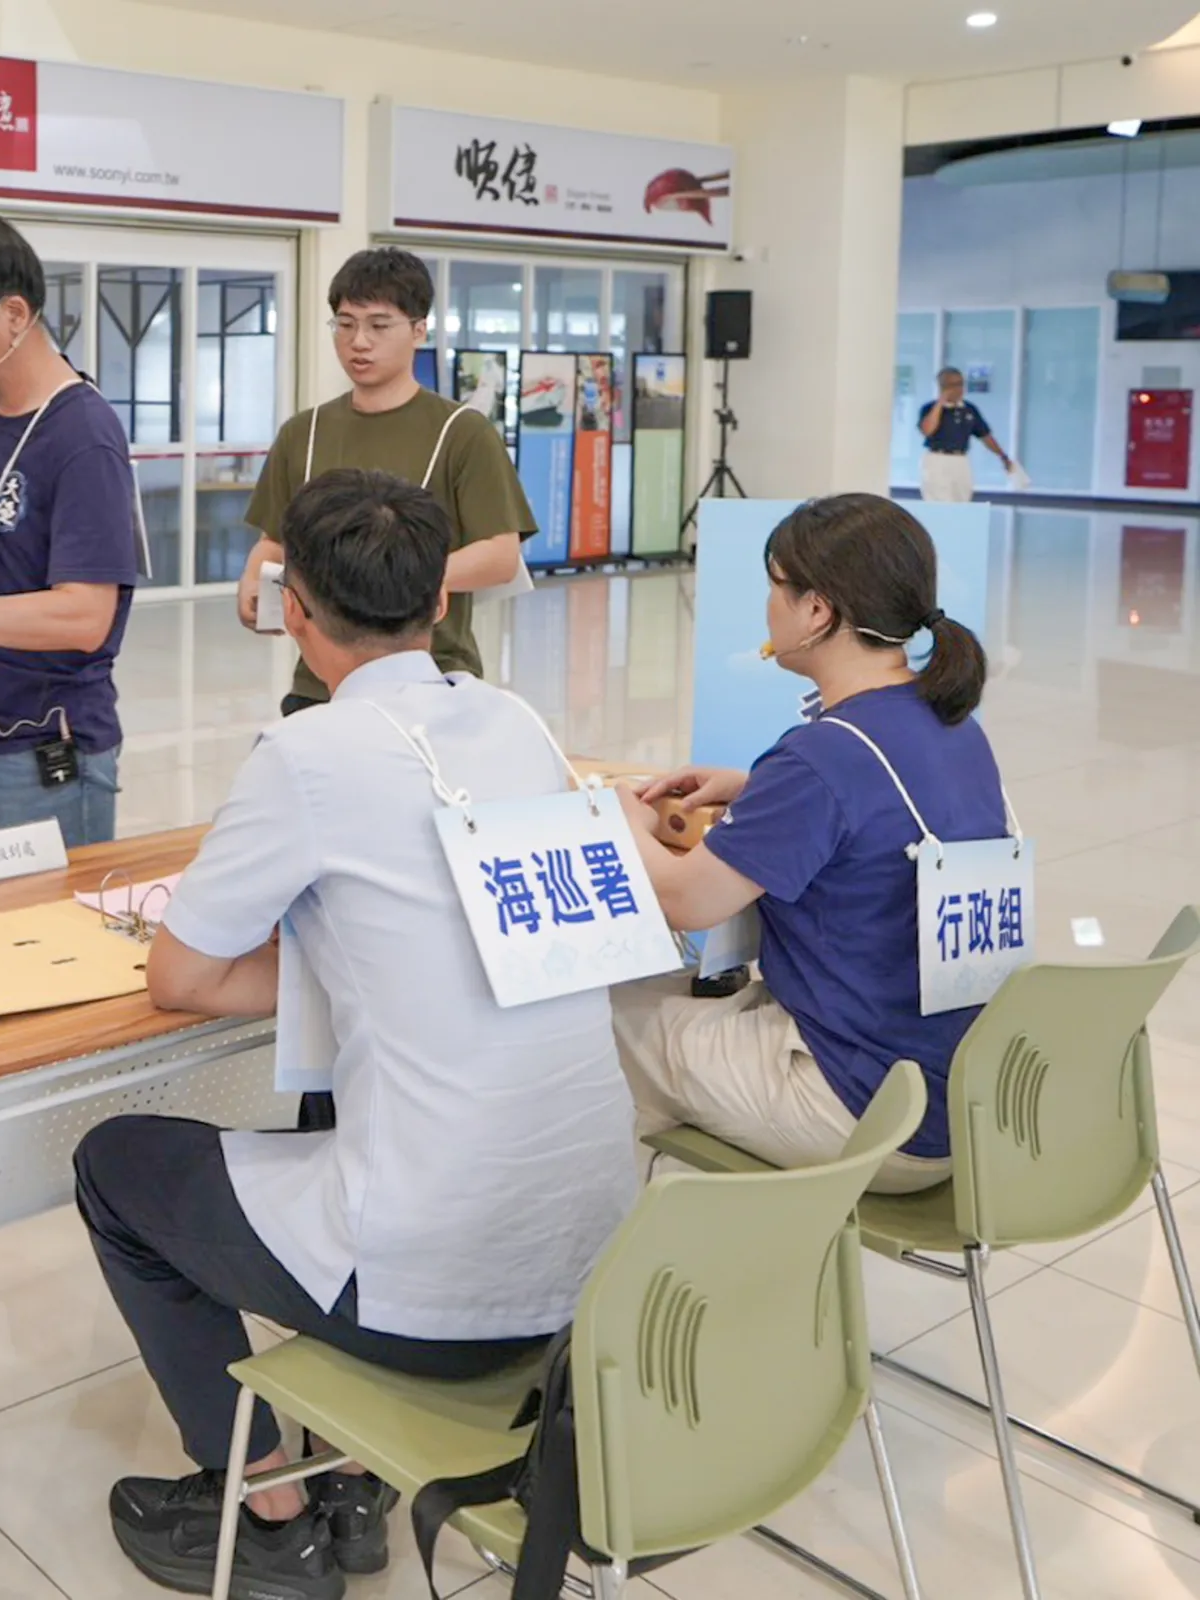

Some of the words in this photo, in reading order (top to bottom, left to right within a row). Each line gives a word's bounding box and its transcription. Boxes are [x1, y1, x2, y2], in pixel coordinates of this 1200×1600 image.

[53, 163, 180, 187] www.soonyi.com.tw
[479, 840, 639, 937] 海巡署
[936, 887, 1024, 962] 行政組
